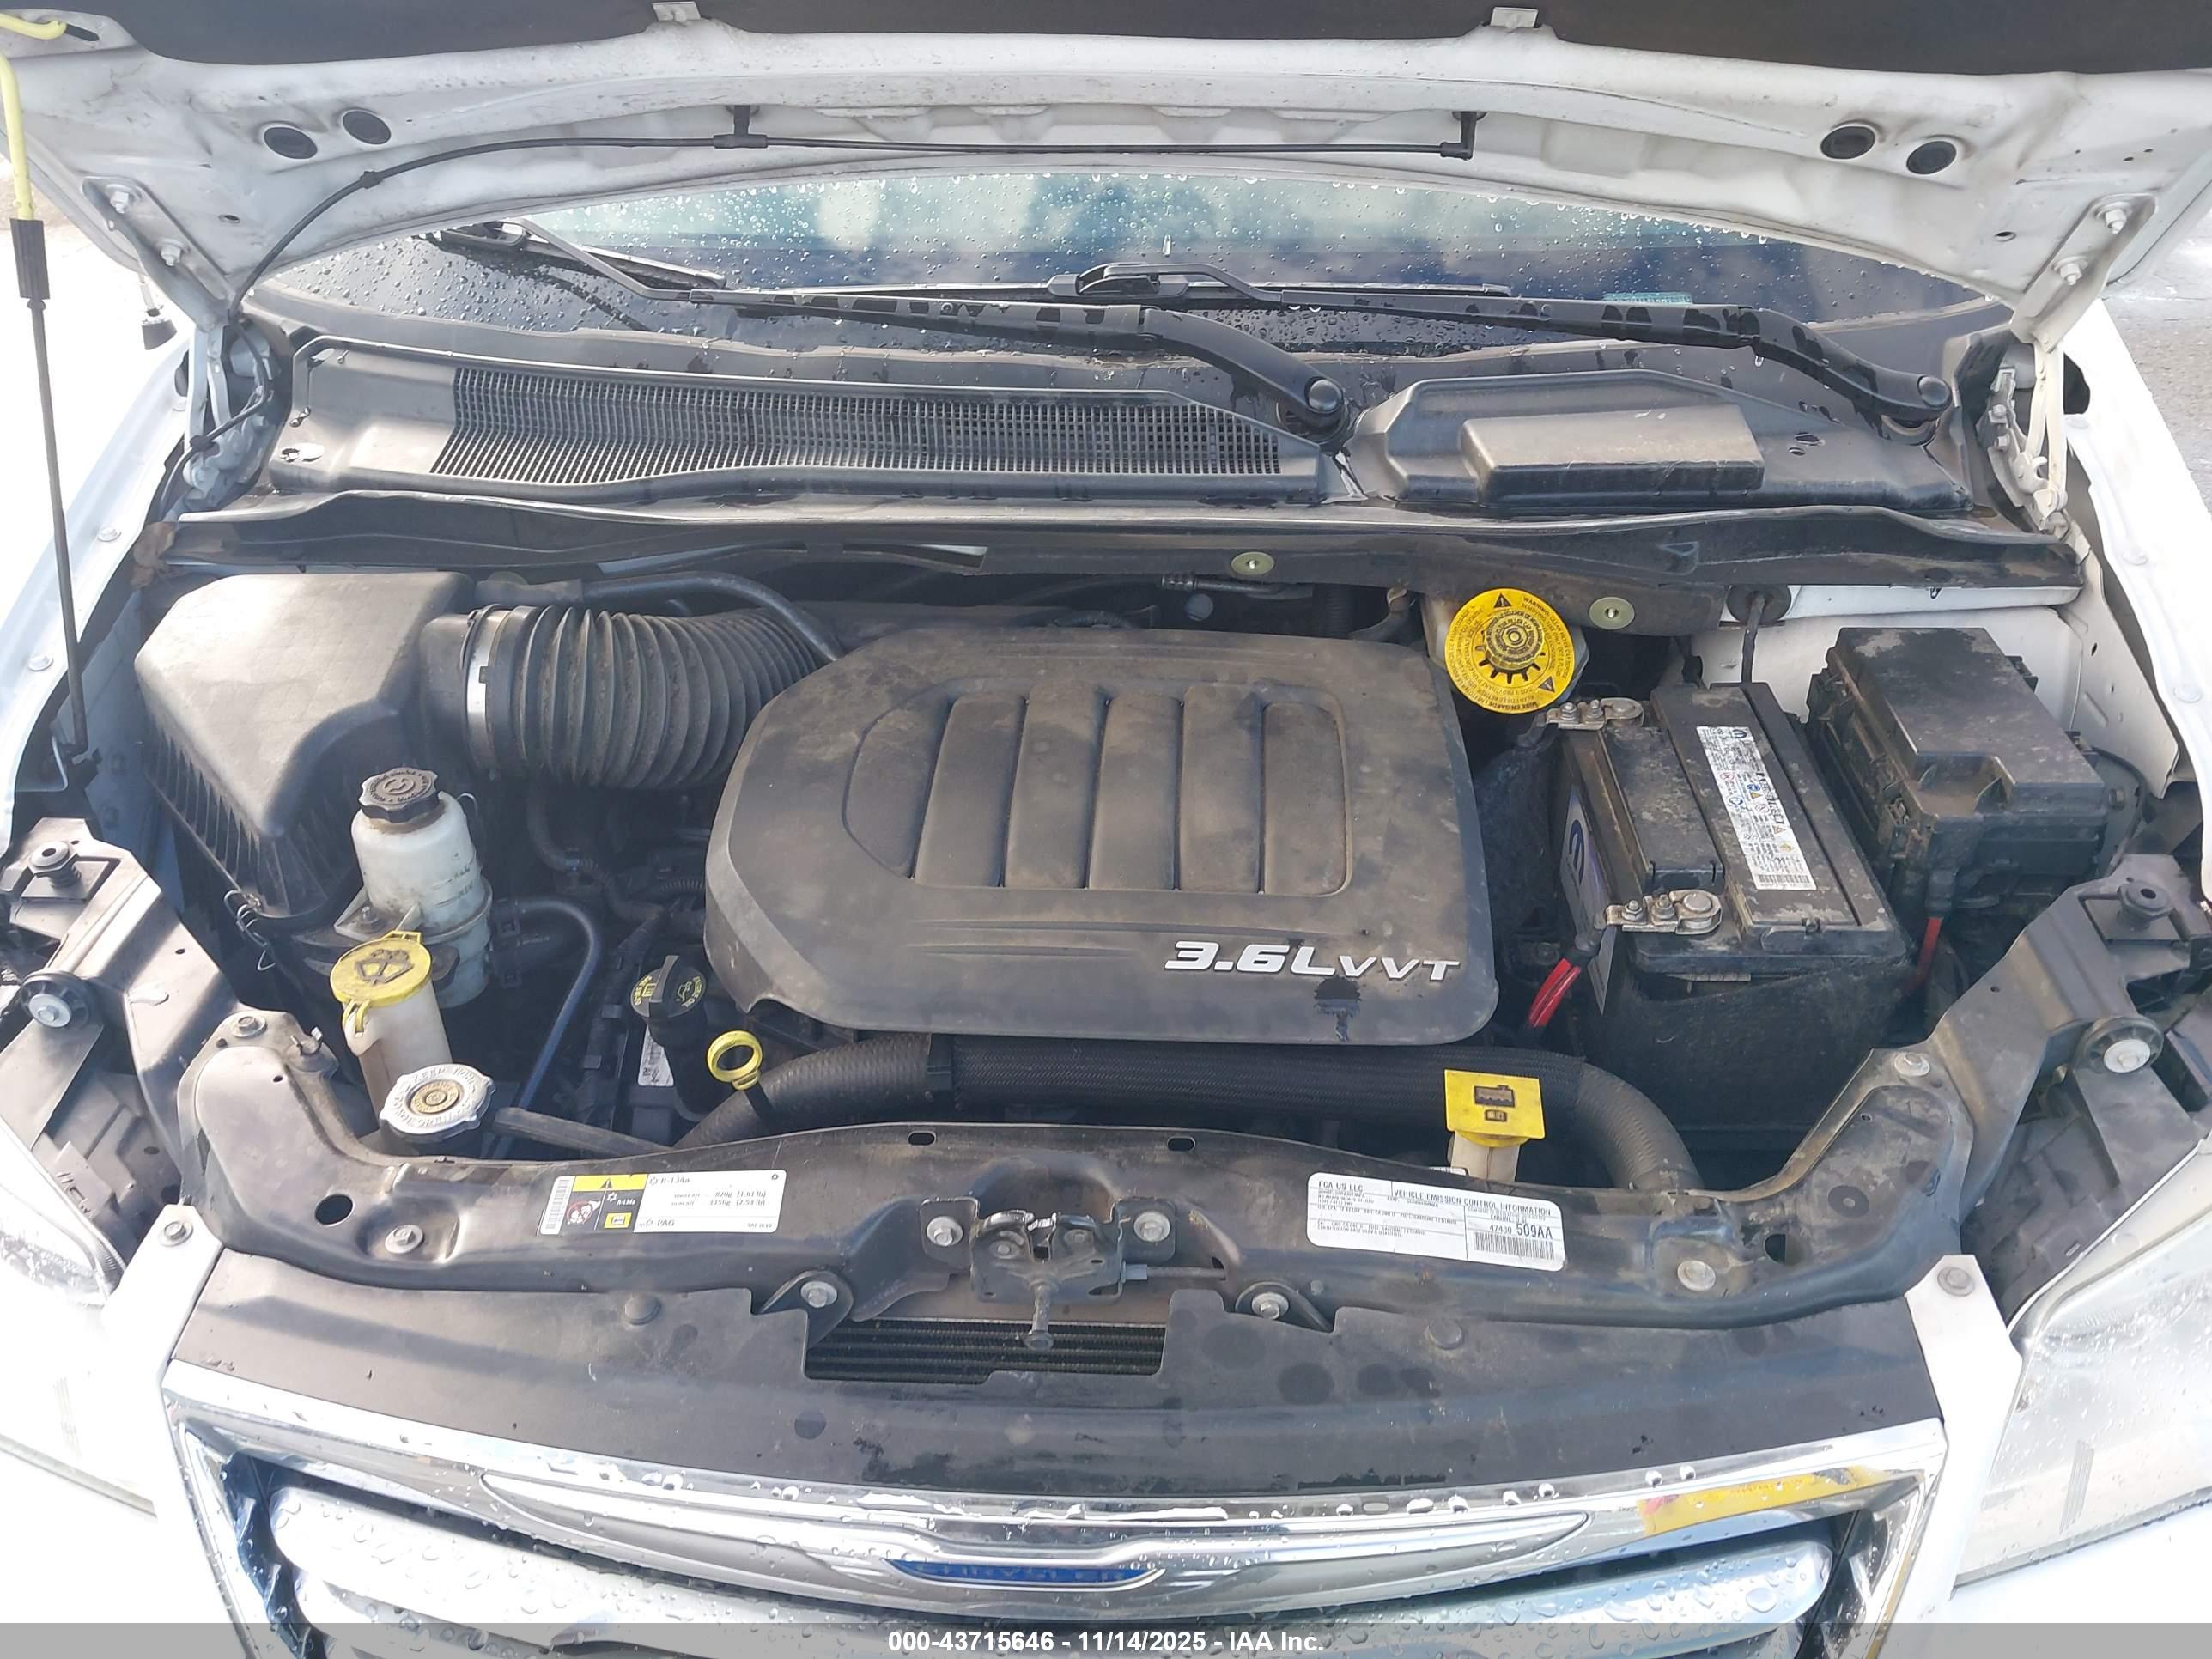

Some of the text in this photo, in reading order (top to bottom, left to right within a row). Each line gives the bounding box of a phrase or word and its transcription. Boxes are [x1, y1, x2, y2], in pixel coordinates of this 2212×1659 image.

[1335, 1182, 1346, 1191] US
[1348, 1183, 1364, 1193] LLC
[1395, 1188, 1425, 1200] VEHICLE
[1426, 1193, 1462, 1205] EMISSION
[1463, 1197, 1497, 1210] CONTROL
[1499, 1202, 1551, 1217] INFORMATION
[1516, 1222, 1553, 1239] 509AA
